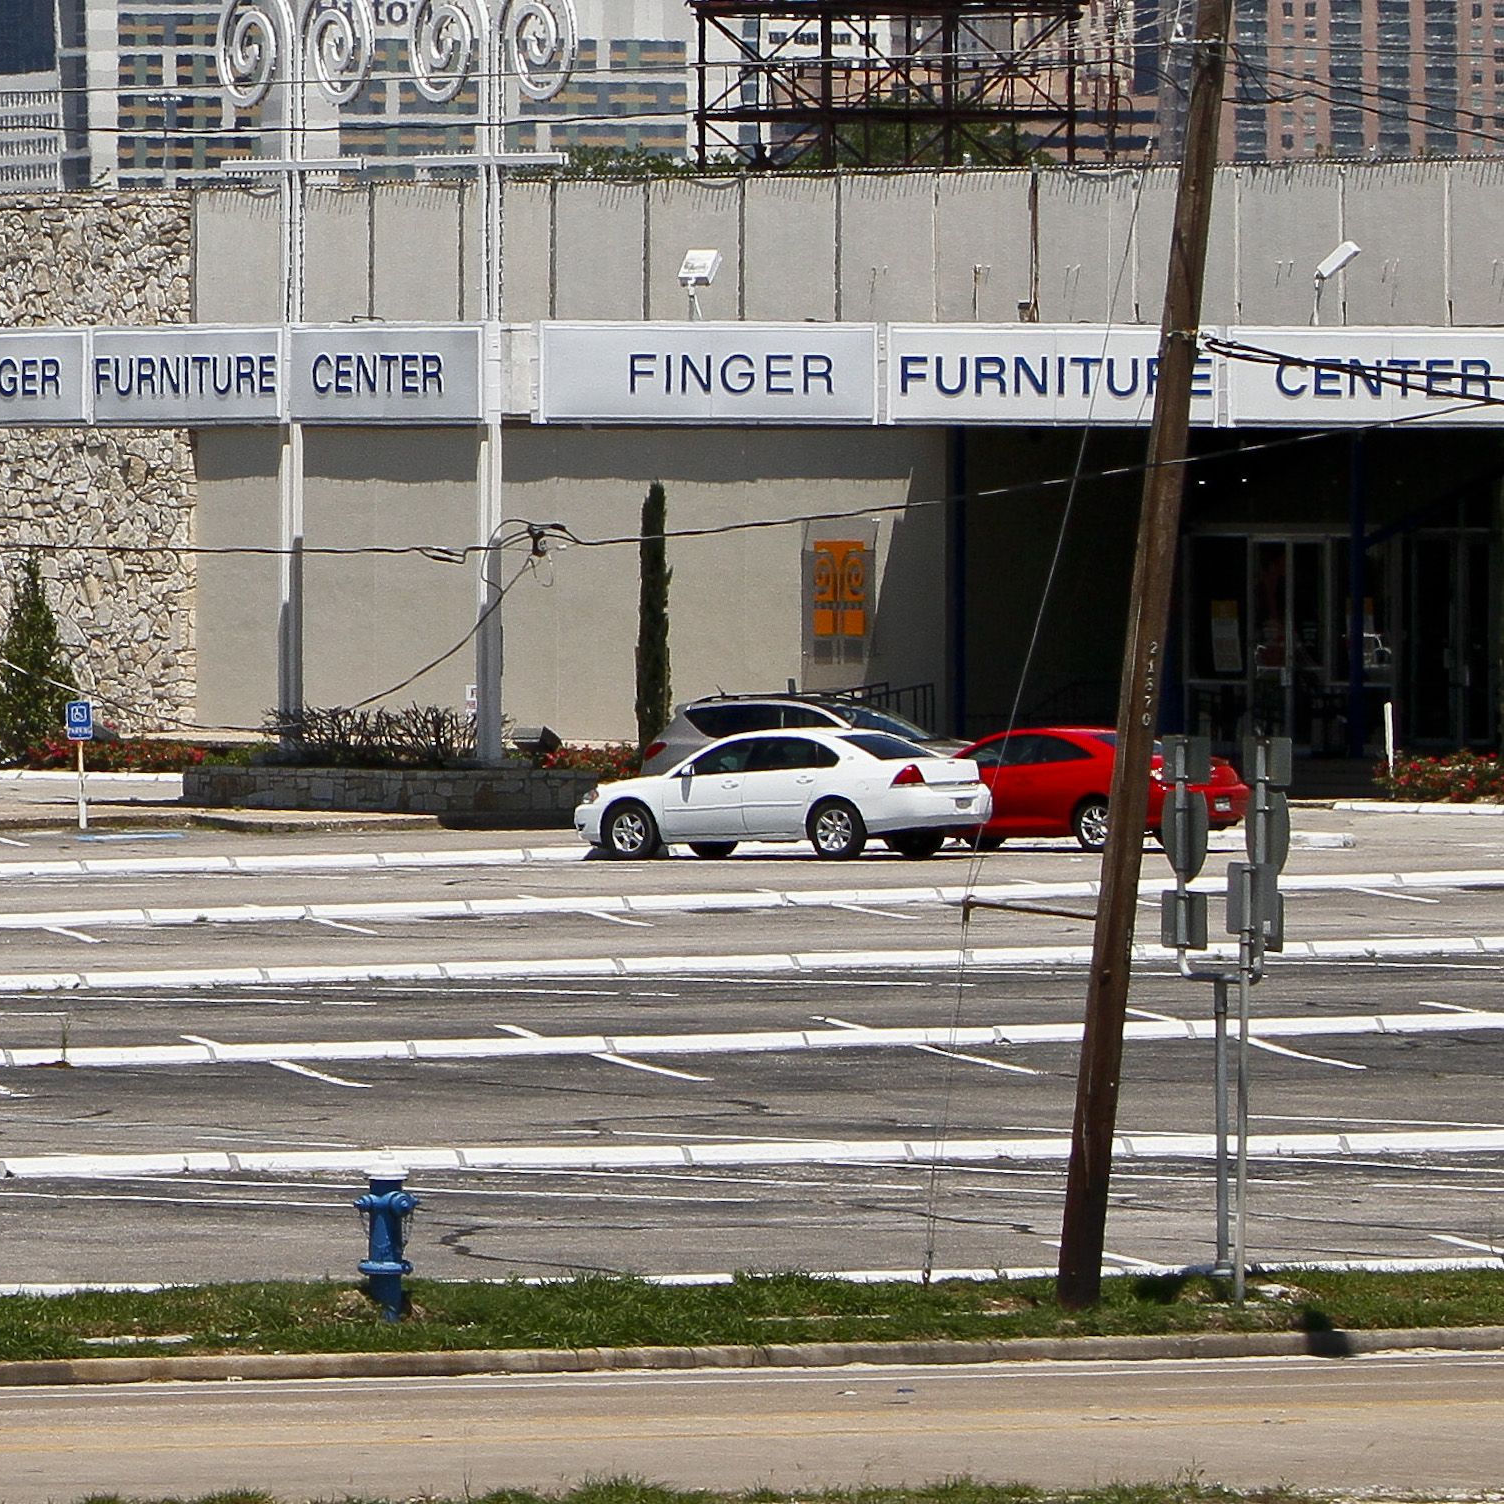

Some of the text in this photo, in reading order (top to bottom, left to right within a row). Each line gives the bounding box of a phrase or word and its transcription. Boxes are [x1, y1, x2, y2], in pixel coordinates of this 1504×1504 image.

[94, 353, 278, 396] FURNITURE
[311, 352, 446, 395] CENTER
[629, 353, 834, 396] FINGER
[1275, 357, 1492, 397] CENTER
